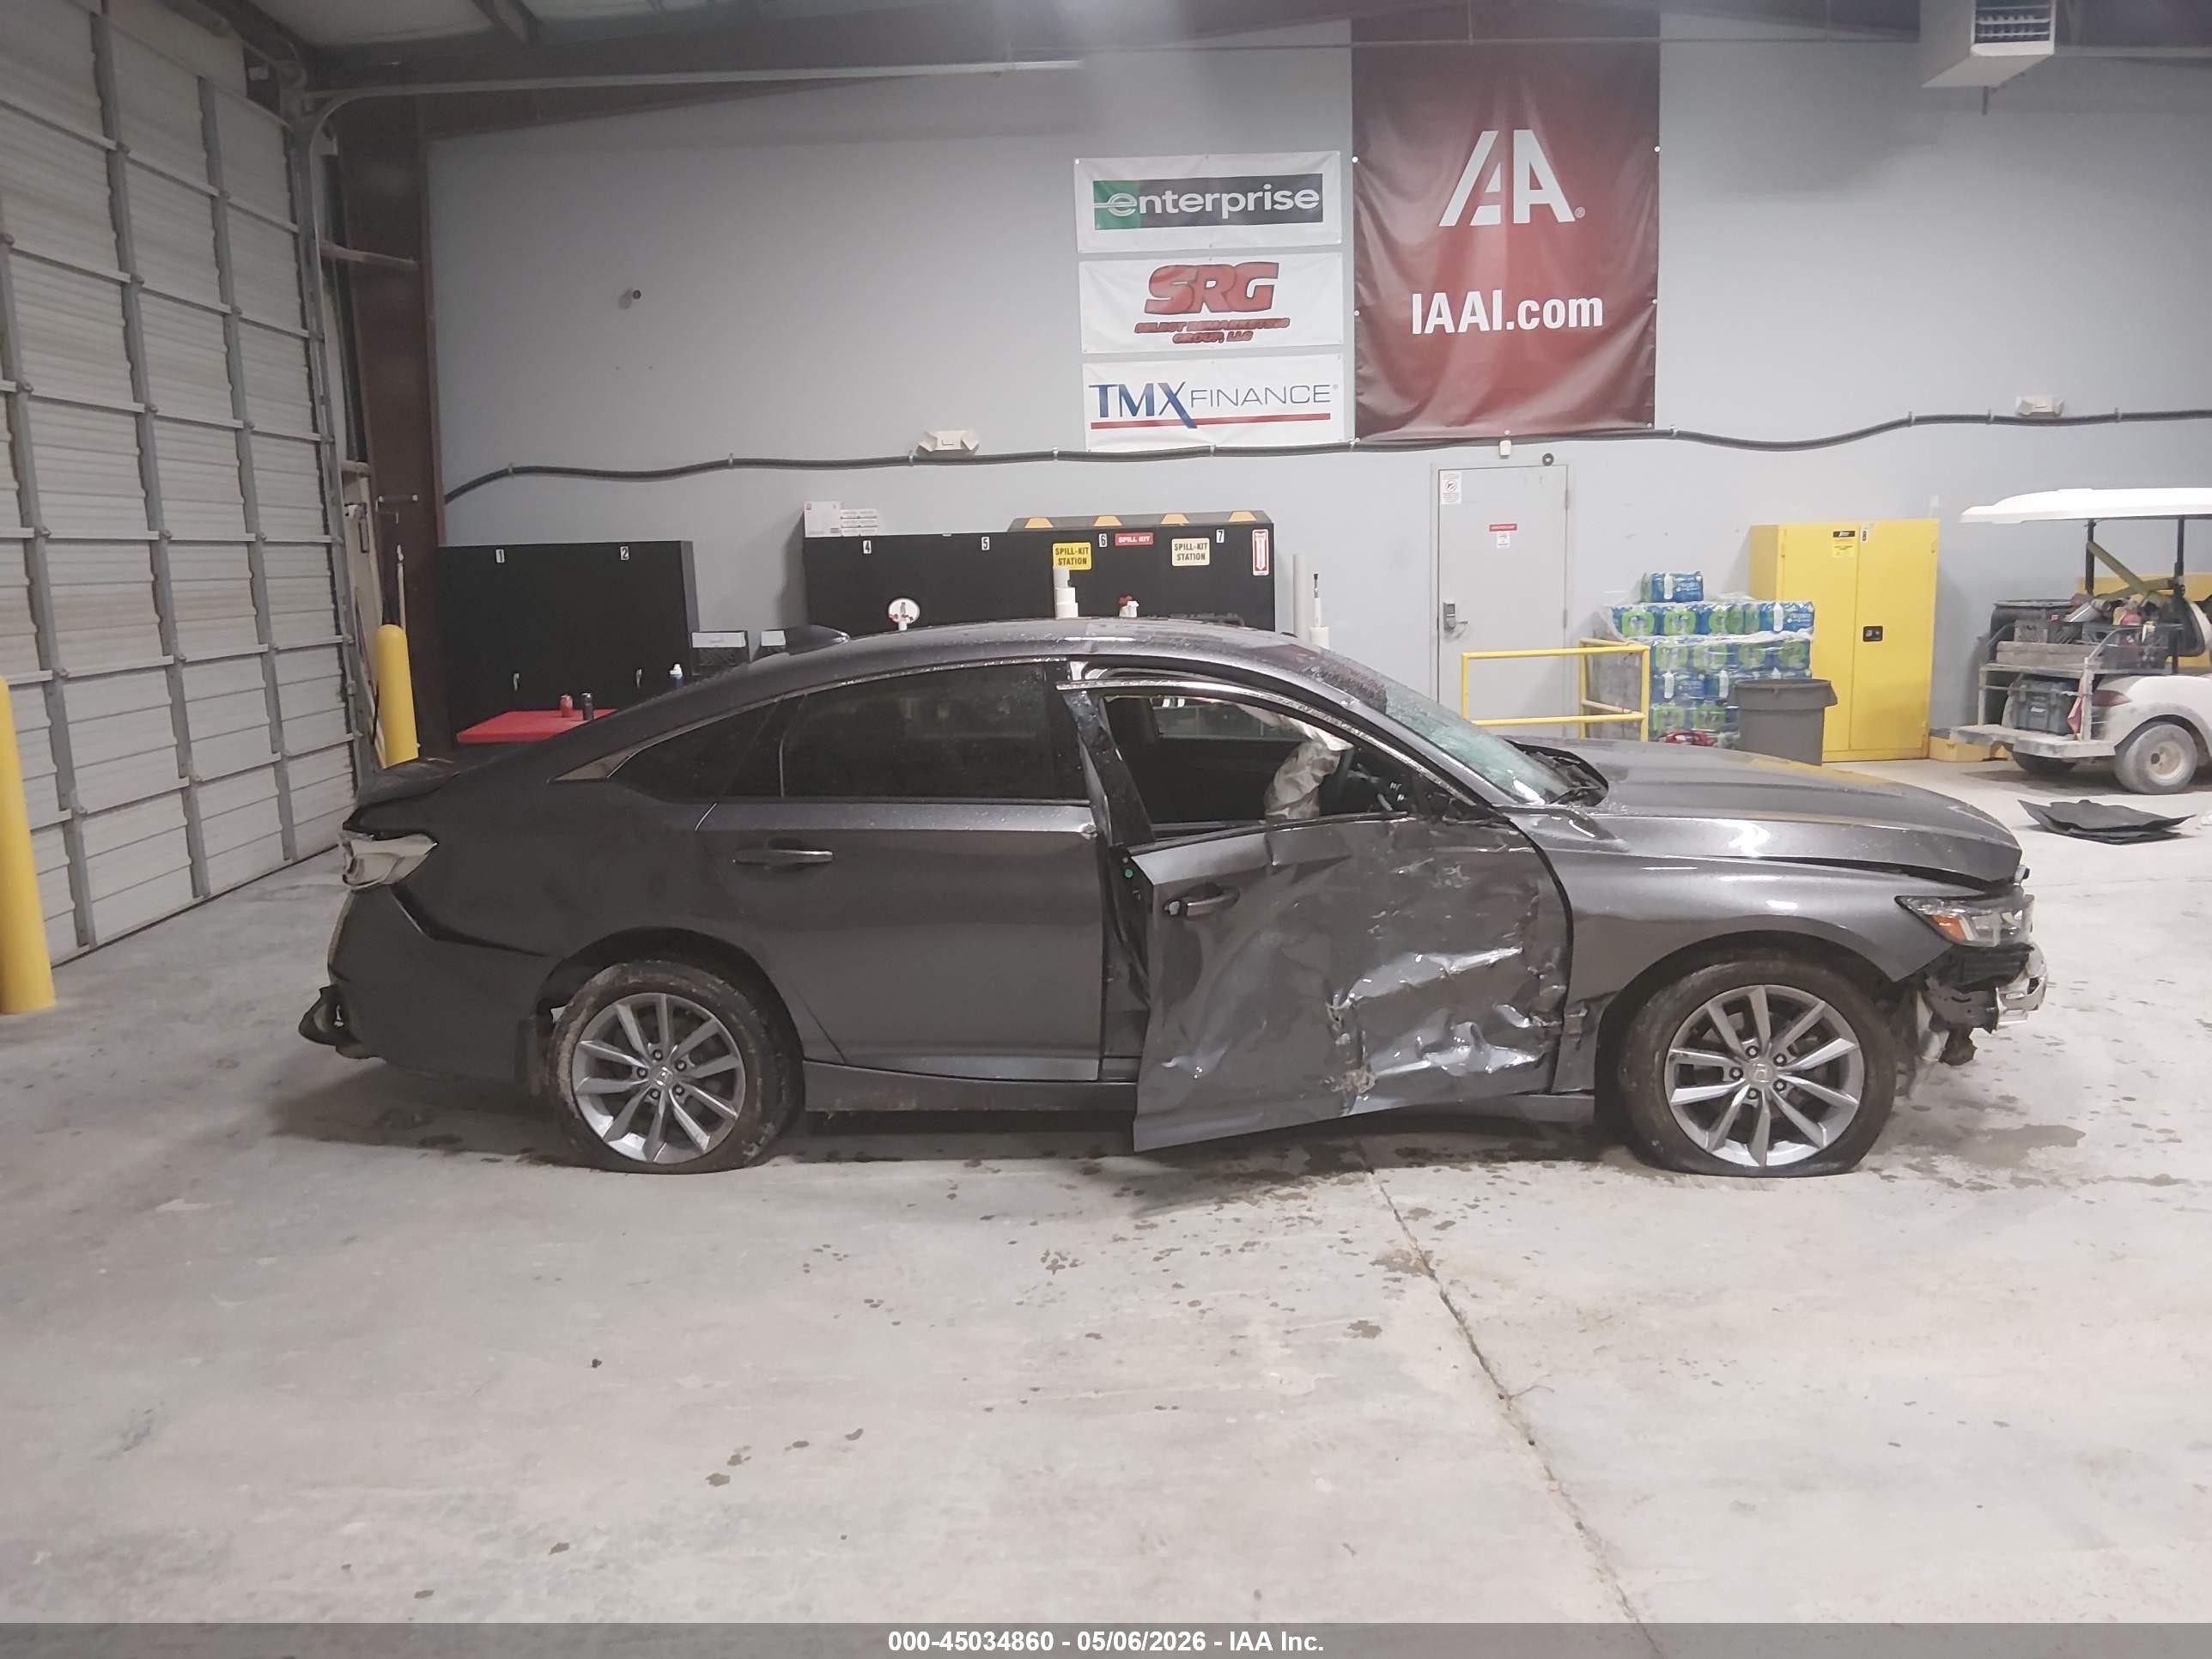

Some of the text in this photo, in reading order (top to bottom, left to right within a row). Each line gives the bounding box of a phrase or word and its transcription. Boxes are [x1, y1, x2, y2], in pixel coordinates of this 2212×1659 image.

[1093, 183, 1320, 220] enterprise
[1144, 261, 1279, 315] SRG
[1412, 289, 1603, 335] IAAI.com
[1088, 381, 1331, 429] TMX FINANCE
[1054, 547, 1090, 556] SPILL-KIT
[1174, 543, 1208, 552] SPILL-KIT
[1176, 552, 1206, 562] STATION
[1057, 556, 1087, 566] STATION
